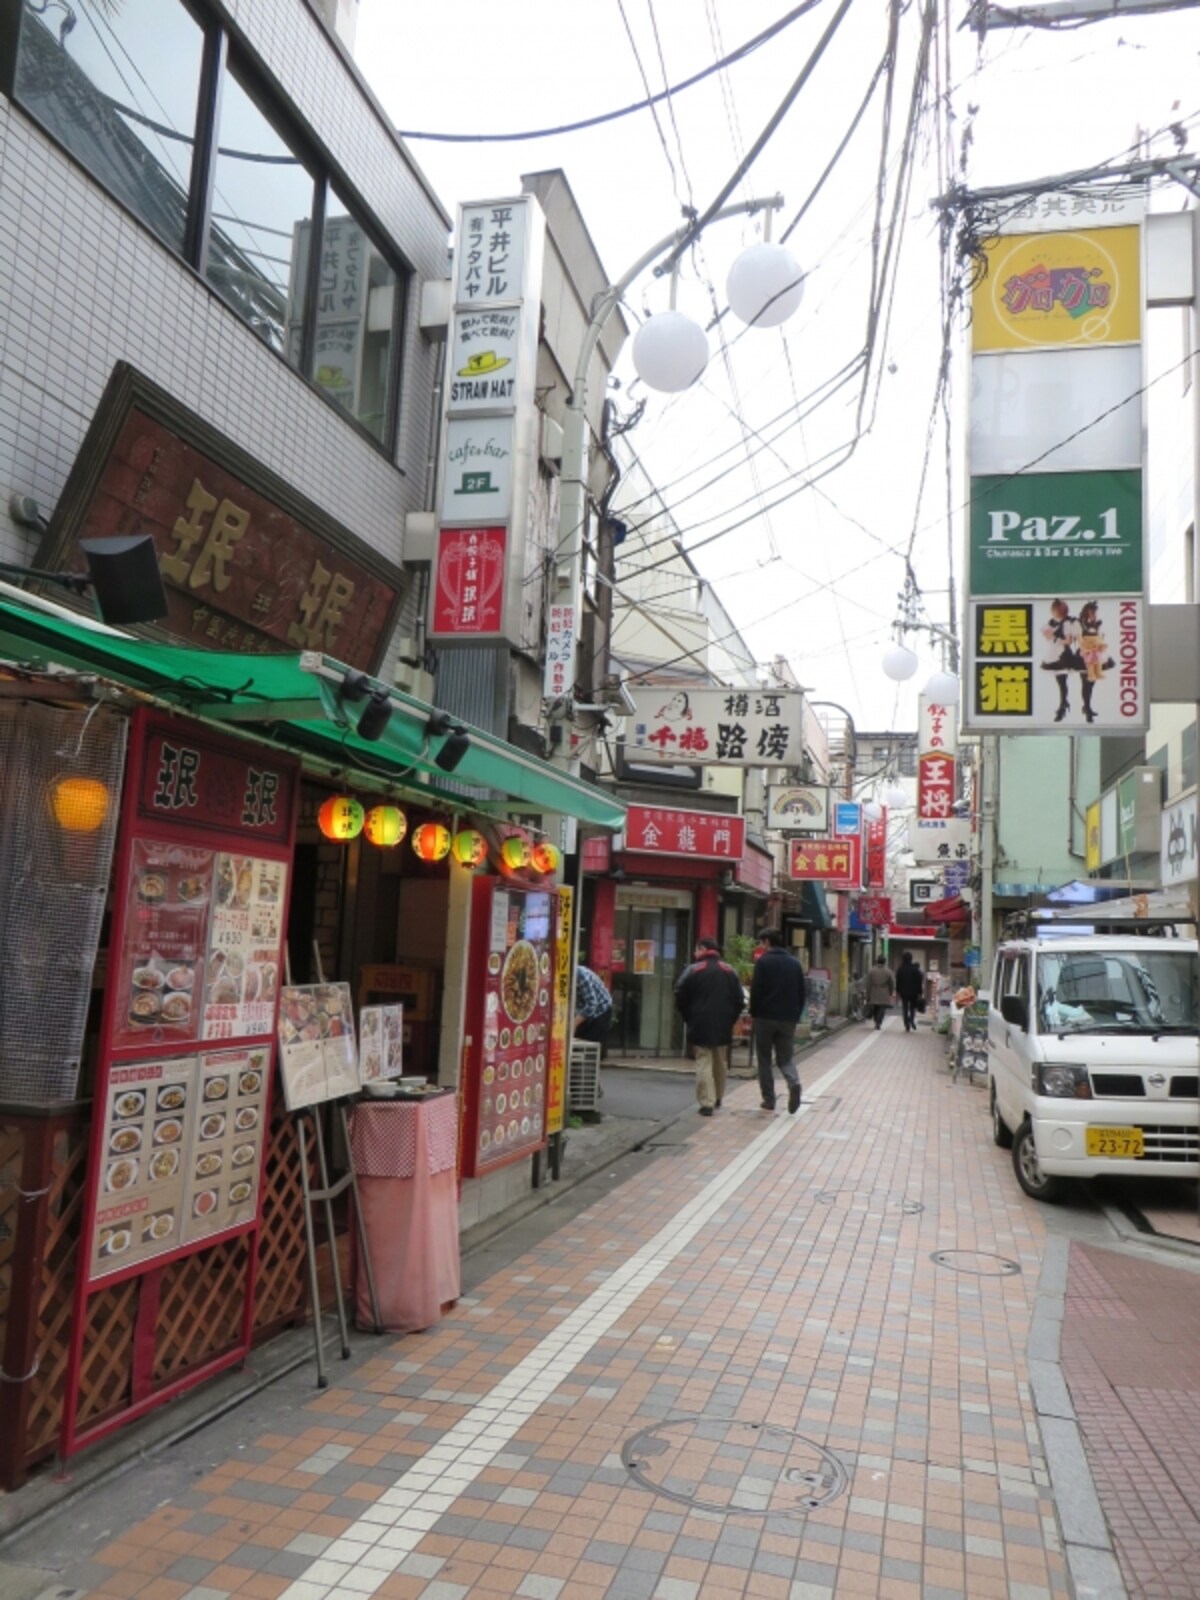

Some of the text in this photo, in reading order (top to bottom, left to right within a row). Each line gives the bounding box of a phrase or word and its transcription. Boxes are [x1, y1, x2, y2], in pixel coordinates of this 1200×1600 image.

[486, 207, 513, 297] 平井ビル
[451, 380, 515, 401] STRAW HAT
[484, 437, 509, 459] bar
[467, 477, 486, 490] 2F
[987, 507, 1121, 542] Paz.1
[979, 608, 1030, 713] 黒猫
[1120, 601, 1138, 718] KURONECO
[716, 723, 790, 760] 路傍
[641, 821, 732, 855] 金龍門
[1098, 1139, 1141, 1155] 23-72
